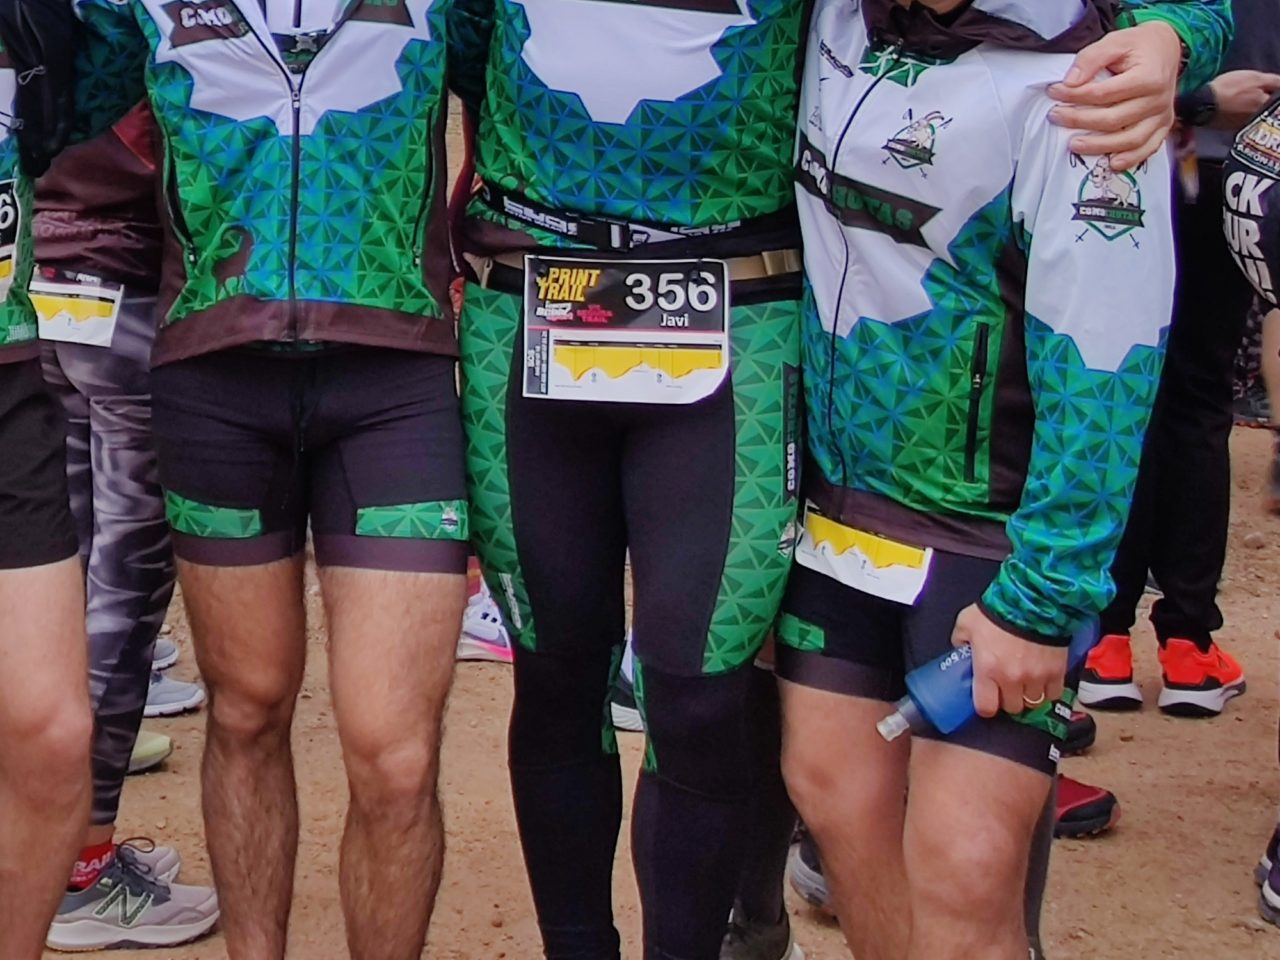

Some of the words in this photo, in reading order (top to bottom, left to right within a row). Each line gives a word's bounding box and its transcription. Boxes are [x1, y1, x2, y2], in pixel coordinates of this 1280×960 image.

[538, 282, 585, 302] TRAIL
[624, 272, 718, 312] 356
[660, 313, 689, 328] Javi
